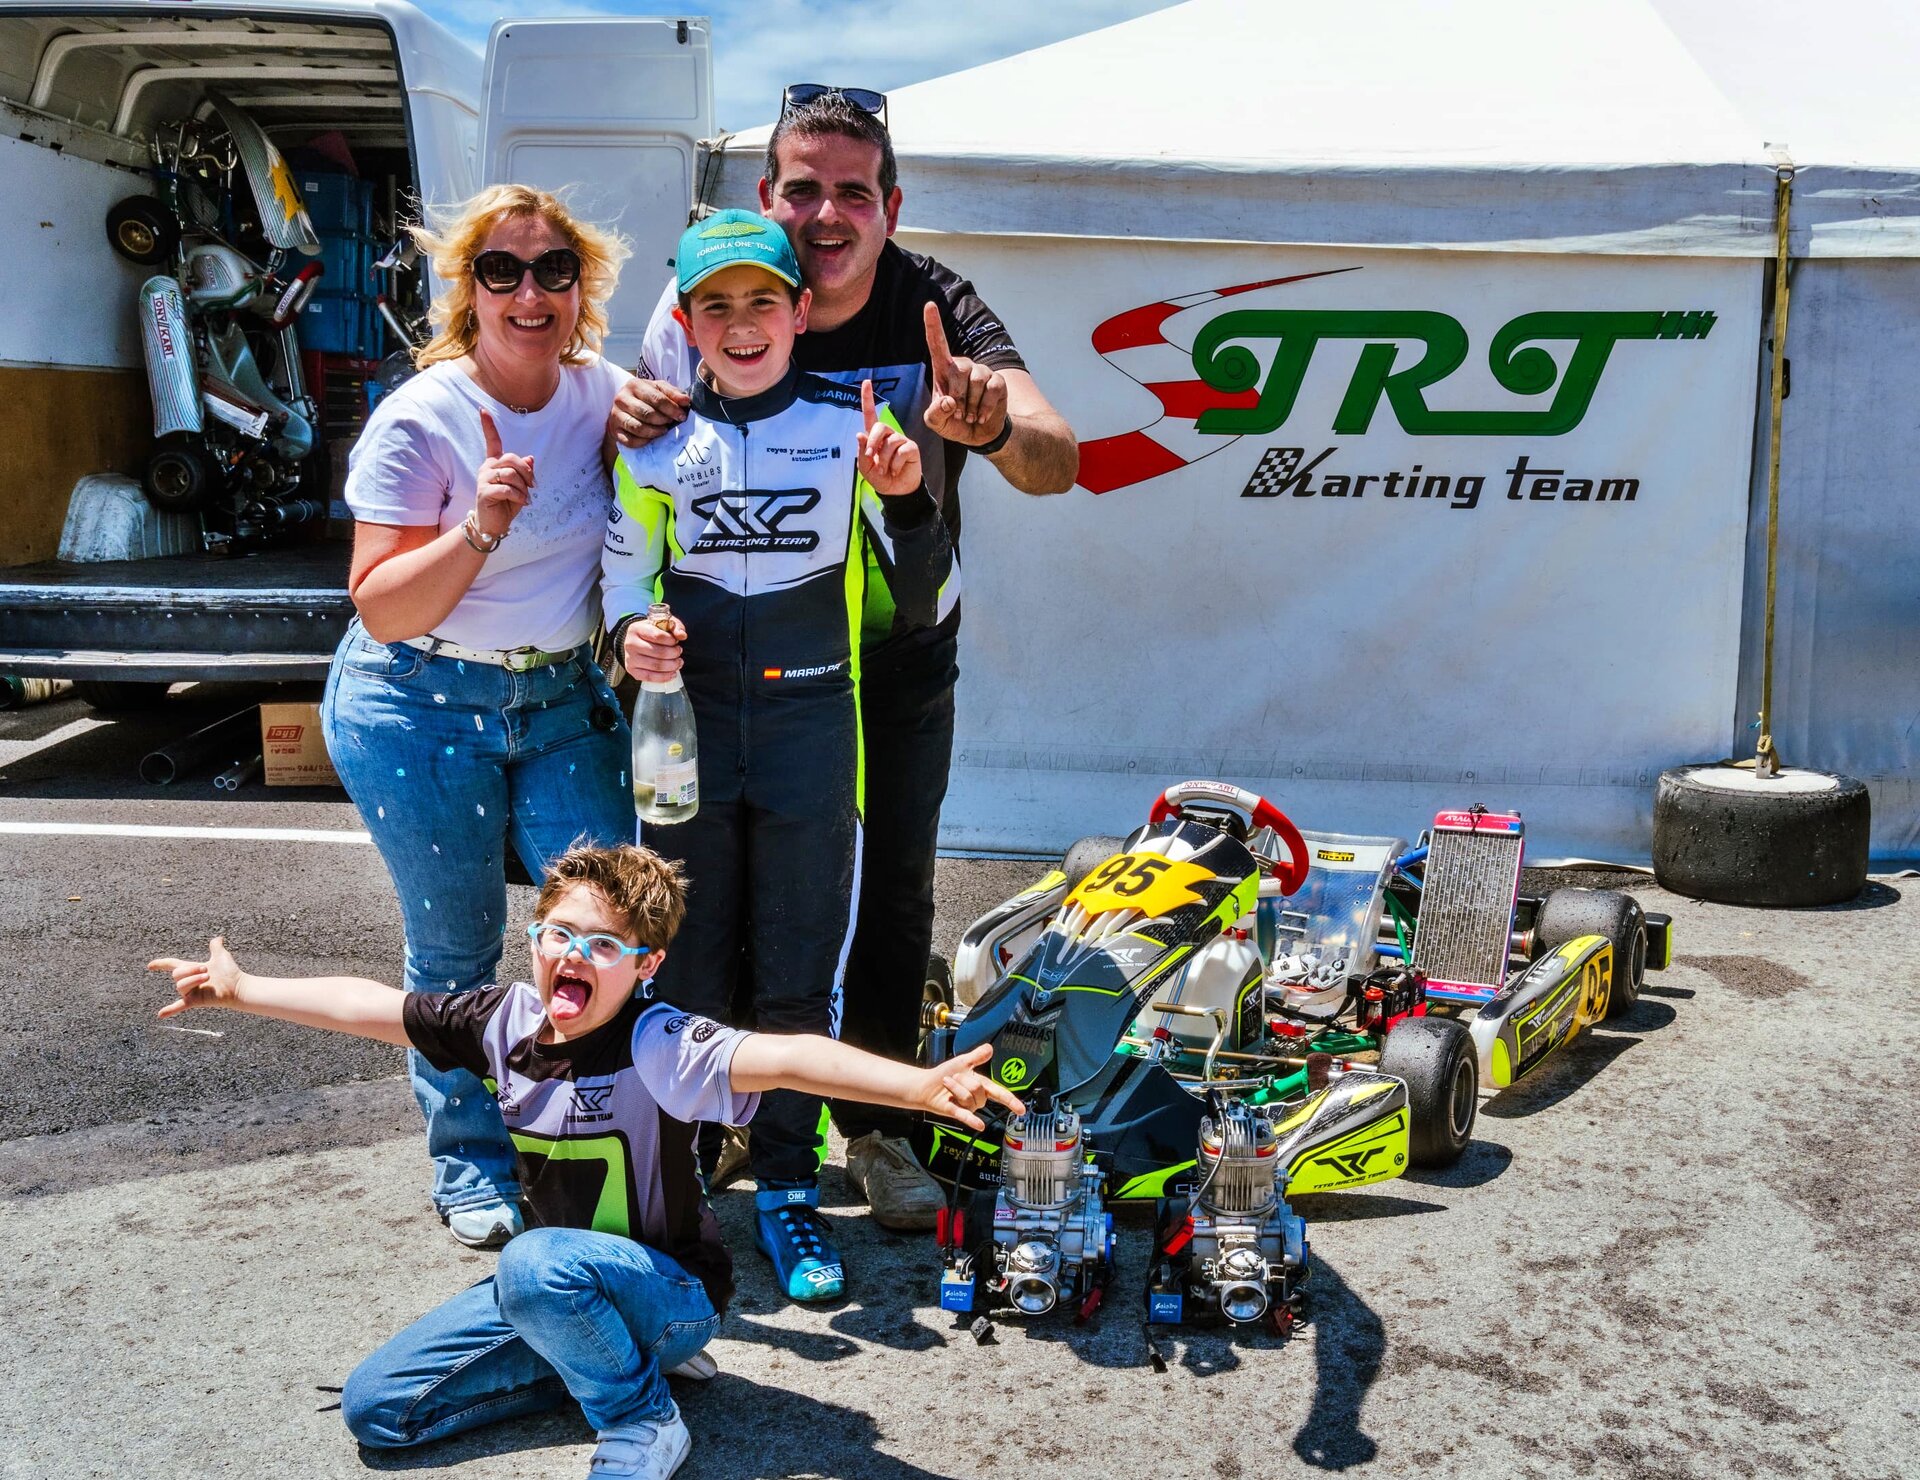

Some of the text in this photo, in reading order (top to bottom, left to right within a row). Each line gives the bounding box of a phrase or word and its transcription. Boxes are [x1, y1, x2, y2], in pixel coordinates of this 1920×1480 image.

[697, 241, 733, 258] FORMULA
[756, 241, 775, 253] TEAM
[1240, 447, 1641, 510] Karting team
[773, 536, 812, 546] TEAM
[783, 666, 826, 678] MARIO
[1083, 856, 1173, 898] 95
[1586, 954, 1610, 1017] 95
[1003, 1022, 1053, 1042] MADERAS
[1001, 1033, 1049, 1057] VARGAS
[598, 1111, 614, 1122] TEAM
[1312, 1169, 1389, 1190] TITO RACING TEAM
[787, 1191, 806, 1201] OMP
[807, 1265, 844, 1283] OMP
